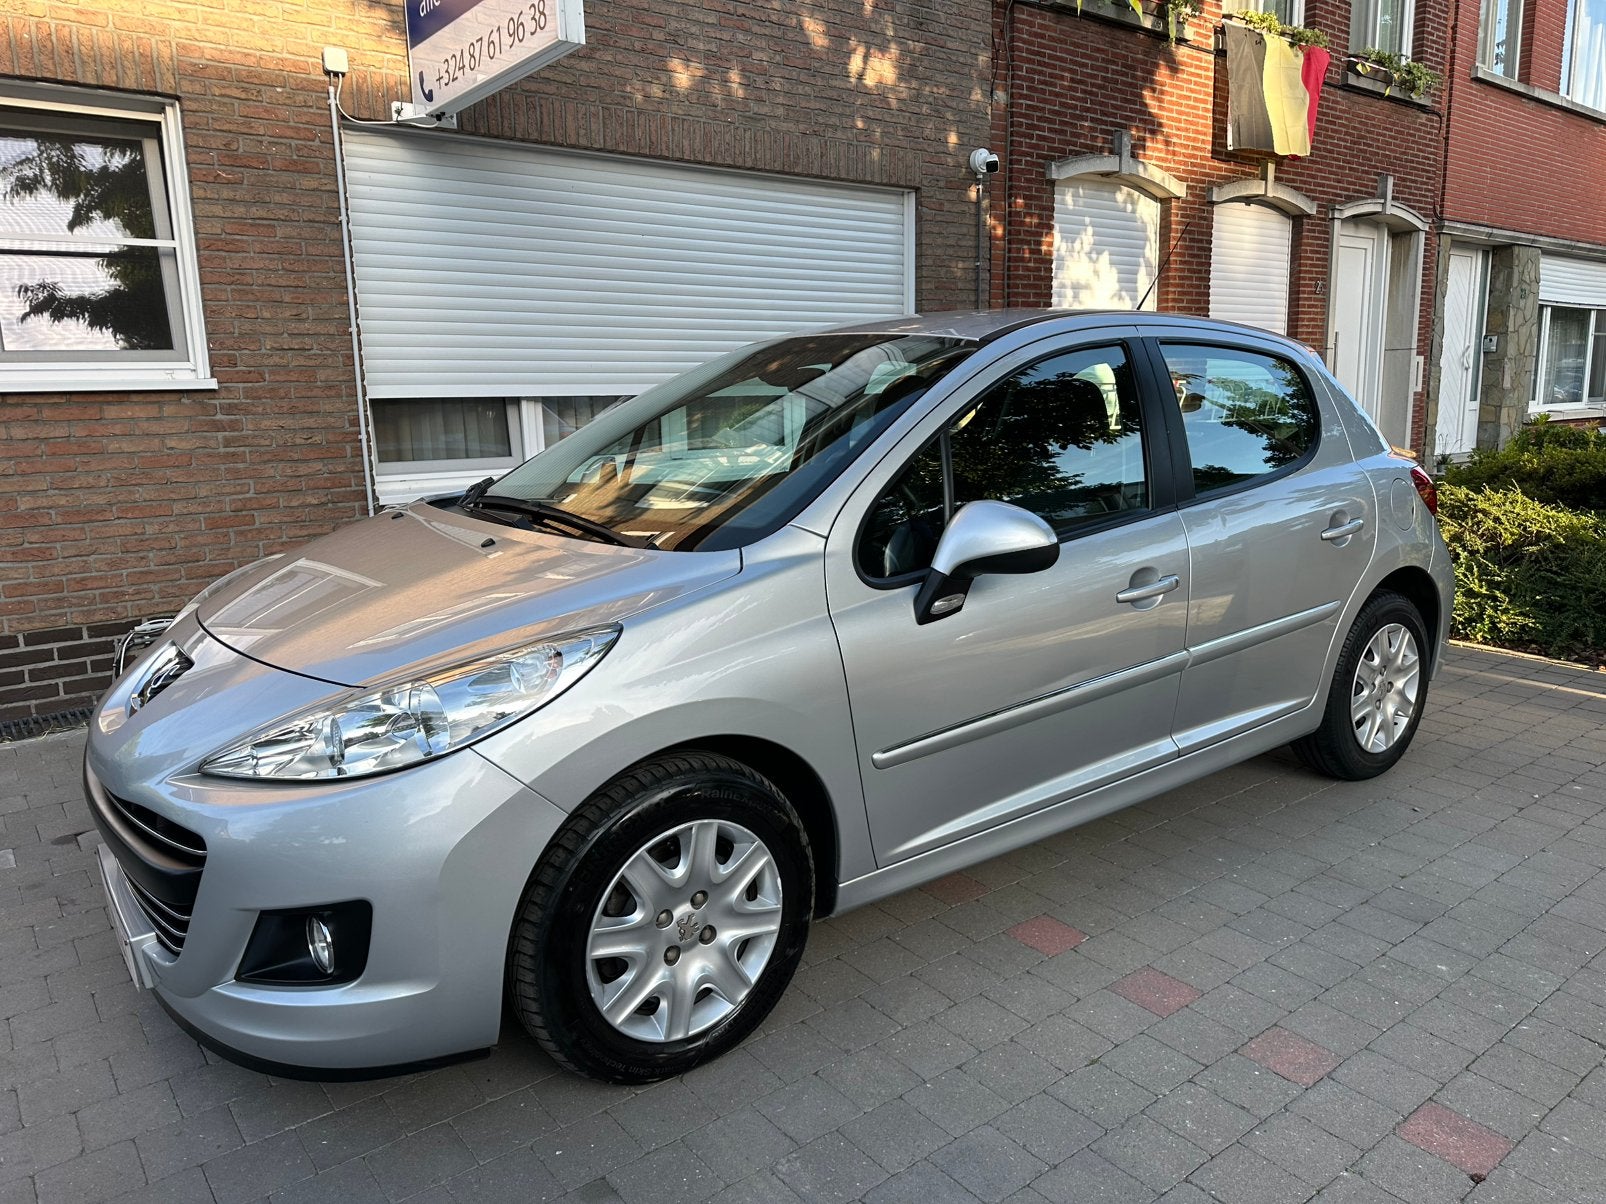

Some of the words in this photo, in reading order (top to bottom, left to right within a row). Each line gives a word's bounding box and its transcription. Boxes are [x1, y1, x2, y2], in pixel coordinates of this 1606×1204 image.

[468, 36, 483, 71] 87
[487, 25, 502, 60] 61
[507, 10, 525, 49] 96
[528, 0, 547, 36] 38
